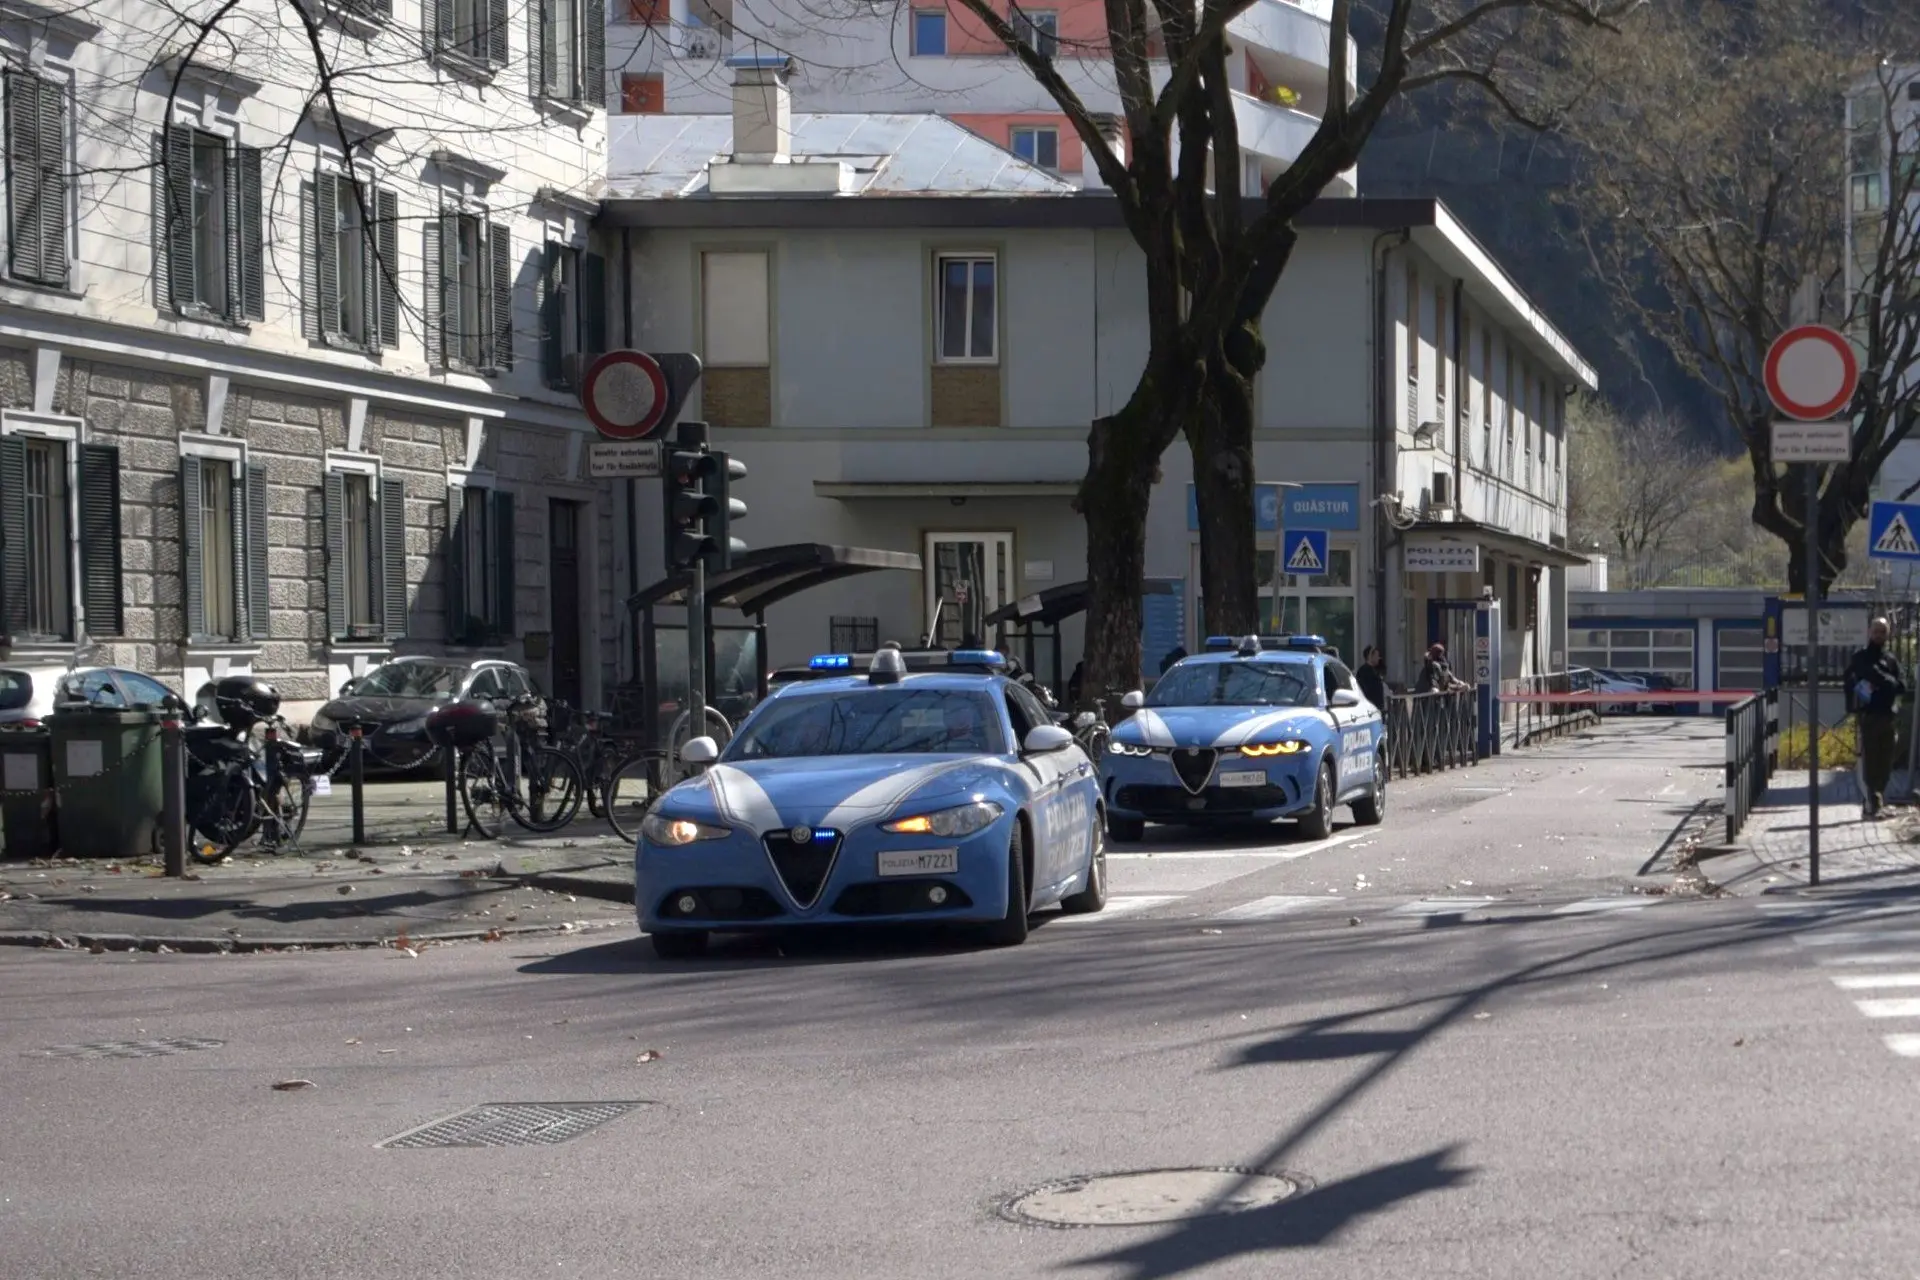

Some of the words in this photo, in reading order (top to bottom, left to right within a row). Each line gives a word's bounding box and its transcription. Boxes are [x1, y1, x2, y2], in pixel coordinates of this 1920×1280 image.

[1406, 547, 1474, 555] POLIZIA
[1408, 558, 1473, 566] POLIZEI
[1343, 727, 1372, 754] POLIZIA
[882, 857, 915, 868] POLIZIA
[917, 853, 953, 869] M7221
